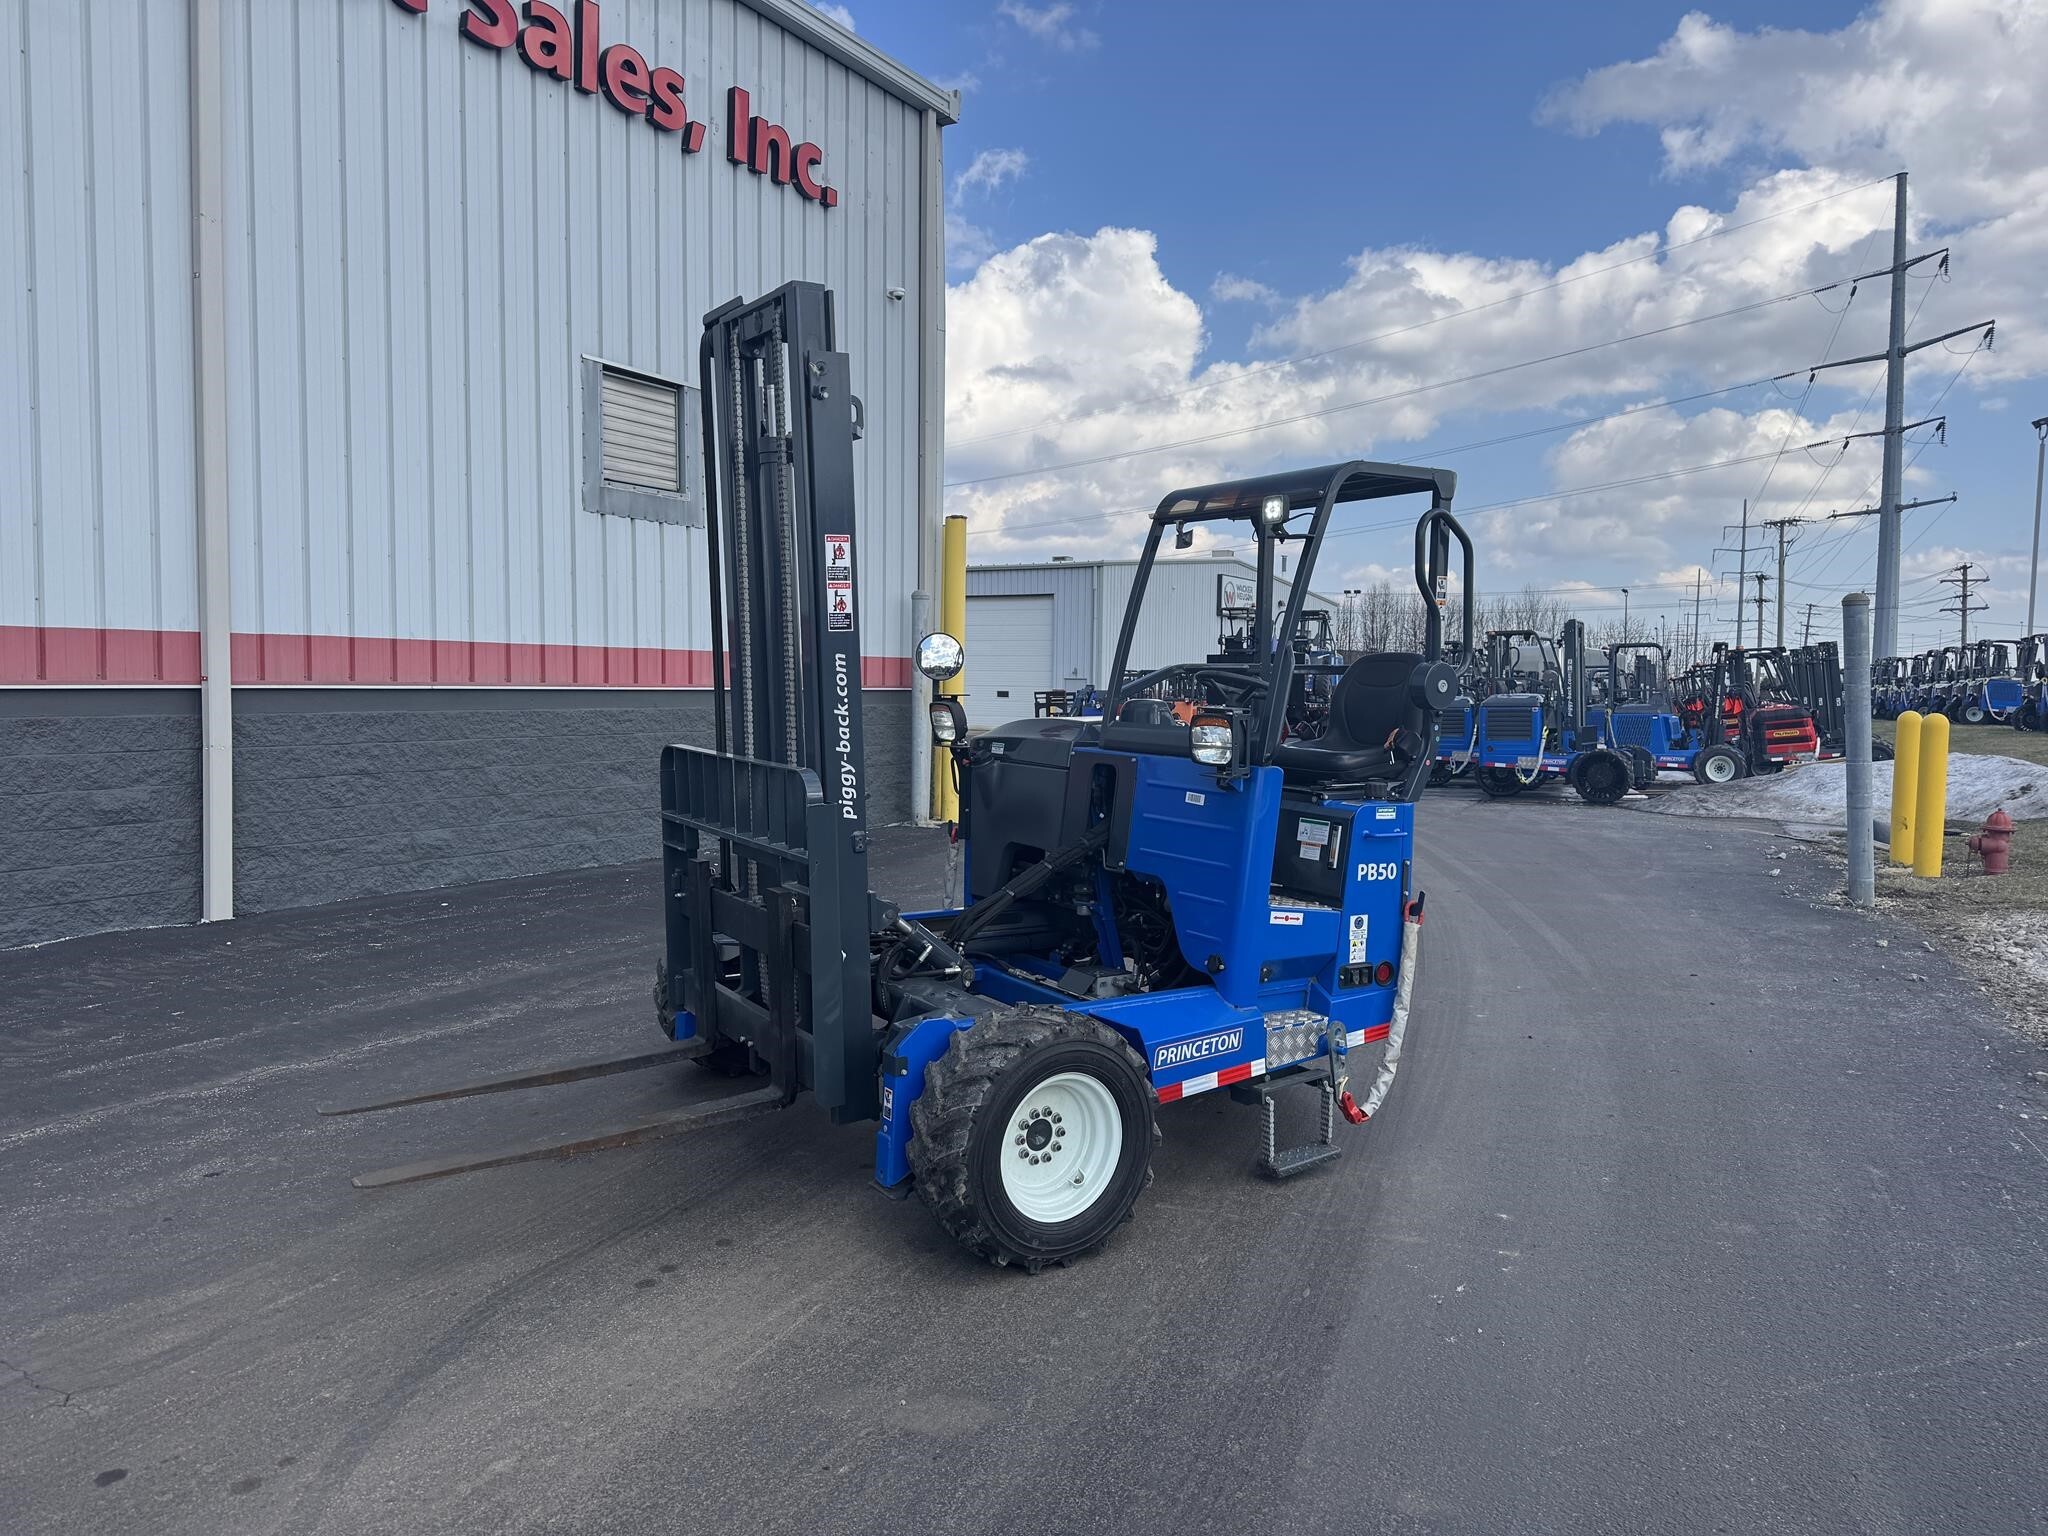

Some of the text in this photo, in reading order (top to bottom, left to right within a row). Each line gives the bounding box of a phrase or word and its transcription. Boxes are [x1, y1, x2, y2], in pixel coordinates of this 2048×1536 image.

[727, 86, 838, 207] Inc.
[834, 653, 857, 820] piggy-back.com
[1357, 862, 1397, 881] PB50
[1157, 1031, 1240, 1066] PRINCETON
